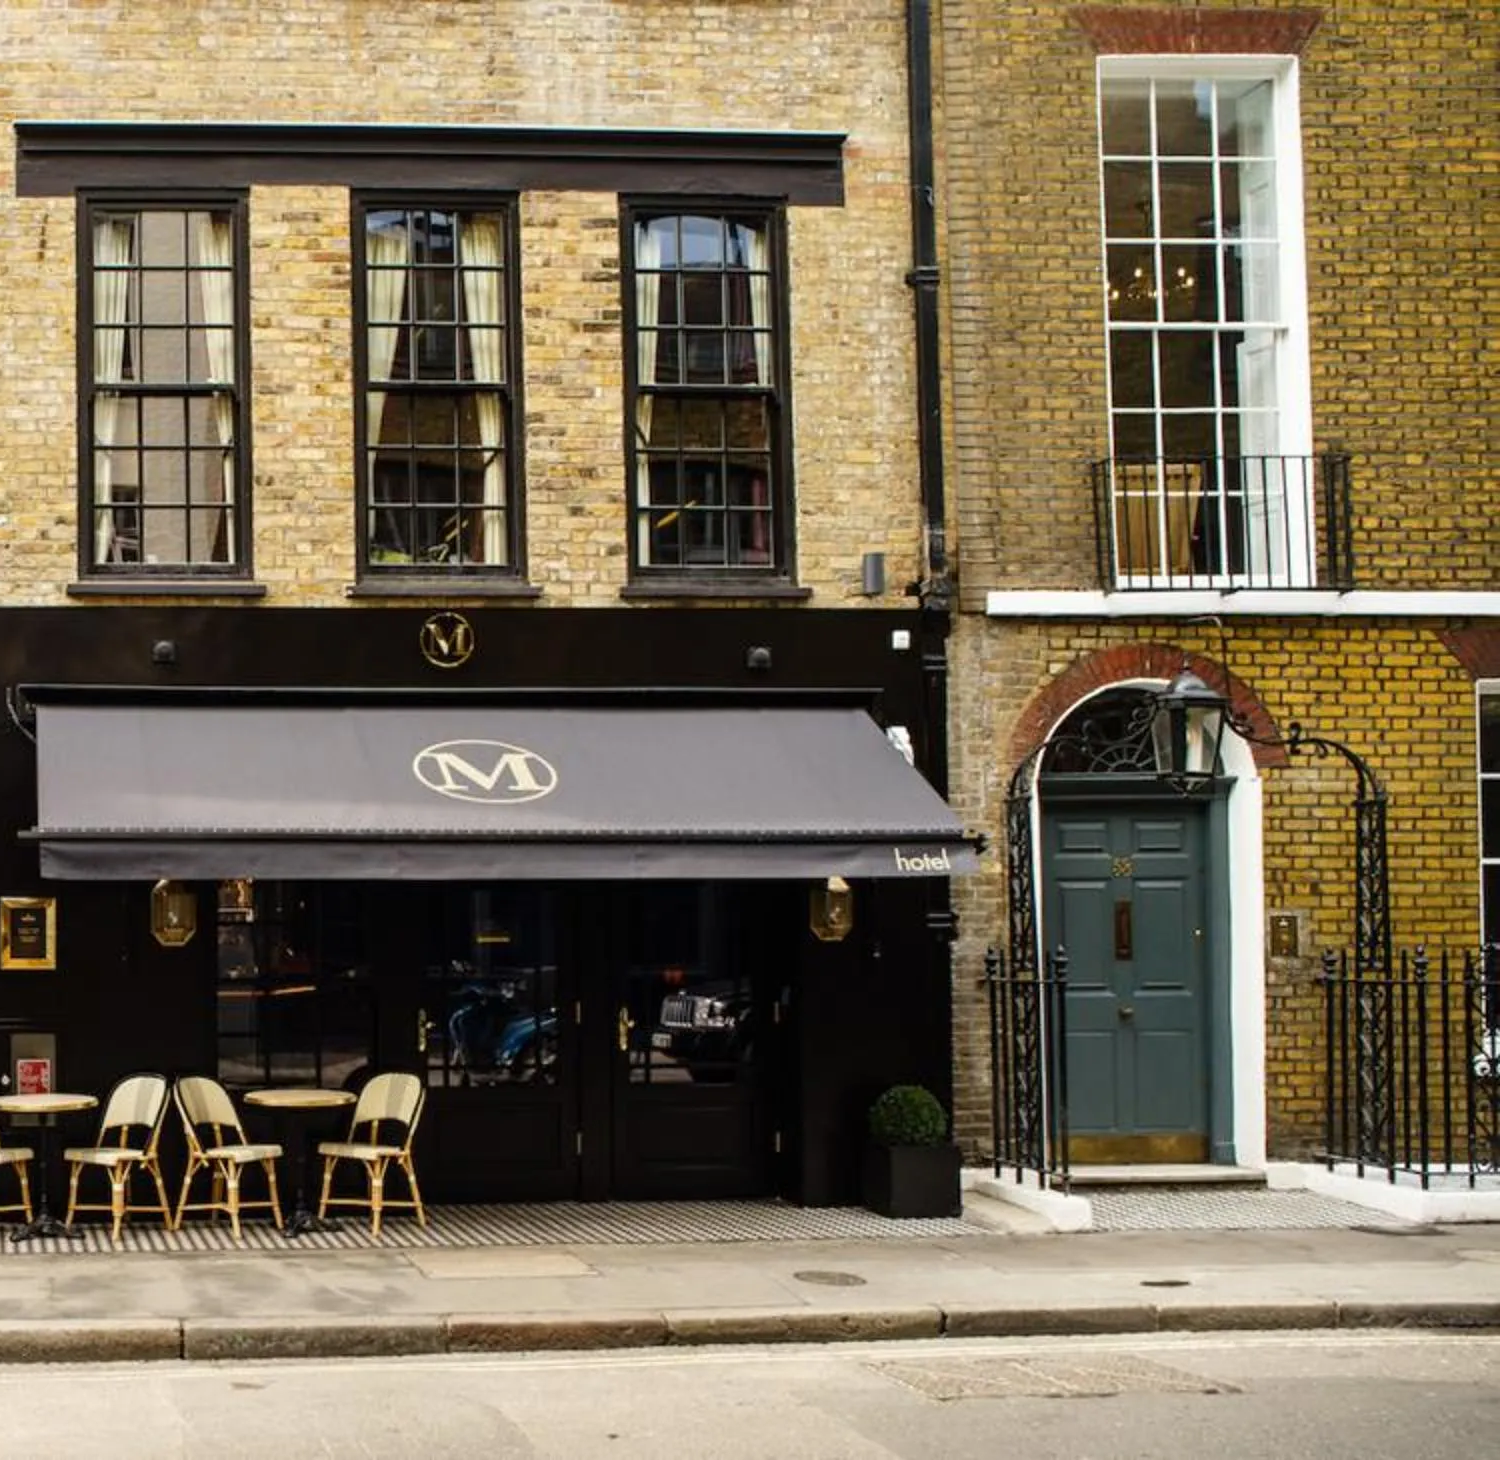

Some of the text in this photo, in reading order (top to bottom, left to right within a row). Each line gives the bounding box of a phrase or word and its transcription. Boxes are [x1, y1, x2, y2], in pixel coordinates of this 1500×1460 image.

[425, 622, 470, 656] M
[418, 751, 552, 791] M
[894, 846, 951, 872] hotel
